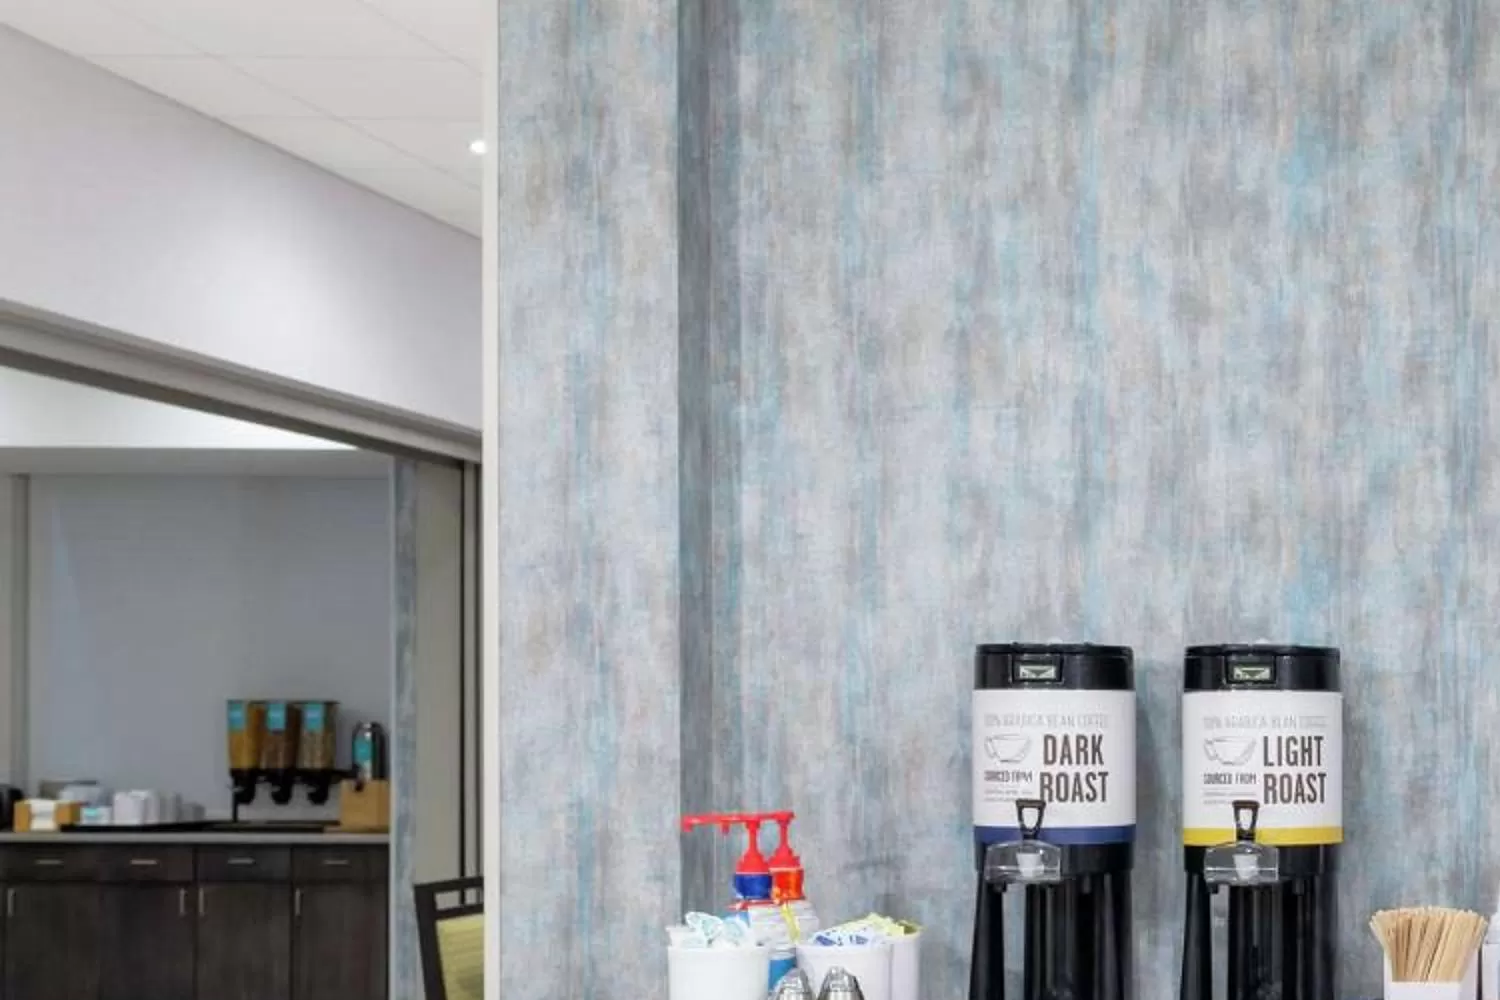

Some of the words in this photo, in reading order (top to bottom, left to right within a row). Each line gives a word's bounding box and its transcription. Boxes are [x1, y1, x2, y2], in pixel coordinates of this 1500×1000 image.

[1043, 734, 1104, 766] DARK
[1263, 735, 1324, 767] LIGHT
[1039, 771, 1109, 803] ROAST
[1263, 773, 1327, 805] ROAST
